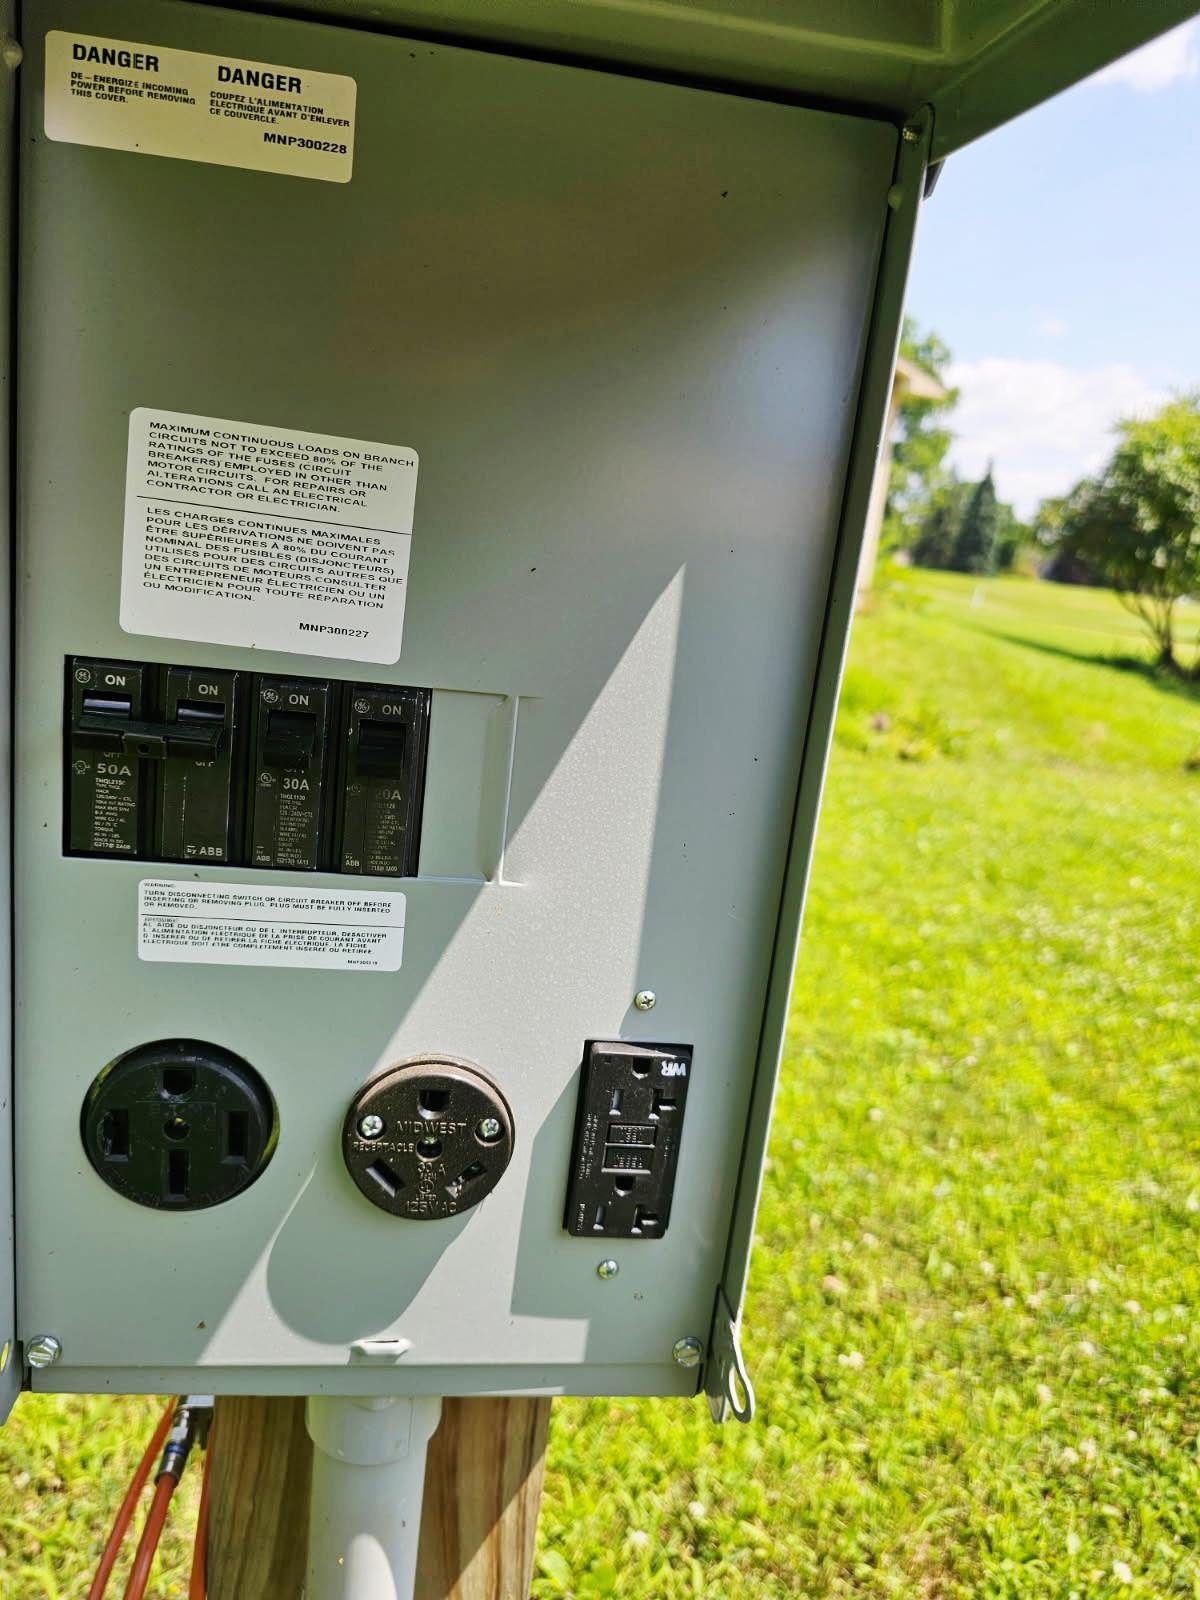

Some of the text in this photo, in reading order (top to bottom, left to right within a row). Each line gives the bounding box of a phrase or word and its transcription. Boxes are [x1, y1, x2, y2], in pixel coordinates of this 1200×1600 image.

[73, 44, 159, 72] DANGER
[142, 82, 189, 95] INCOMING
[218, 65, 301, 93] DANGER
[71, 80, 196, 105] POWER BEFORE REMOVING
[71, 88, 128, 103] THIS COVER.
[210, 91, 324, 115] COUPEZ L'ALIMENTATION
[210, 99, 350, 127] ELECTRIQUE AVANT D'ENLEVER
[224, 110, 279, 124] COUVERCLE.
[264, 132, 347, 154] MNP300228
[149, 432, 383, 471] CIRCUITS NOT TO EXCEED 80% OF THE
[150, 422, 414, 467] MAXIMUM CONTINUOUS LOADS ON BRANCH
[149, 441, 351, 476] RATINGS OF THE FUSES (CIRCUIT
[148, 451, 221, 467] BREAKERS)
[224, 461, 291, 477] EMPLOYED
[311, 474, 351, 486] OTHER
[356, 480, 387, 491] THAN
[148, 460, 367, 497] MOTOR CIRCUITS. FOR REPAIRS OR
[147, 470, 367, 507] ALTERATIONS CALL AN ELECTRICAL
[147, 480, 340, 513] CONTRACTOR OR ELECTRICIAN.
[147, 507, 381, 545] LES CHARGES CONTINUES MAXIMALES
[147, 516, 395, 556] POUR LES DÉRIVATIONS NE DOIVENT PAS
[145, 535, 394, 575] NOMINAL DES FUSIBLES (DISJONCTEURS)
[146, 525, 388, 564] ÊTRE SUPÉRIEURES À 80% DU COURANT
[145, 554, 169, 563] DES
[173, 557, 229, 571] CIRCUITS
[233, 565, 249, 573] DE
[145, 545, 403, 584] UTILISES POUR DES CIRCUITS AUTRES QUE
[143, 582, 255, 601] OU MODIFICATION.
[144, 562, 385, 600] UN ENTREPRENEUR ÉLECTRICIEN OU UN
[144, 571, 384, 609] ÉLECTRICIEN POUR TOUTE RÉPARATION
[299, 622, 369, 638] MNP300227
[105, 674, 126, 686] ON
[198, 684, 218, 696] ON
[288, 694, 309, 706] ON
[382, 704, 402, 715] ON
[97, 763, 132, 776] 50A
[283, 778, 309, 791] 30A
[199, 846, 223, 856] ABB
[168, 892, 230, 900] DISCONNECTING
[661, 1060, 686, 1076] WR
[396, 1120, 467, 1135] MIDWEST
[353, 1141, 415, 1152] RECEPTACLE
